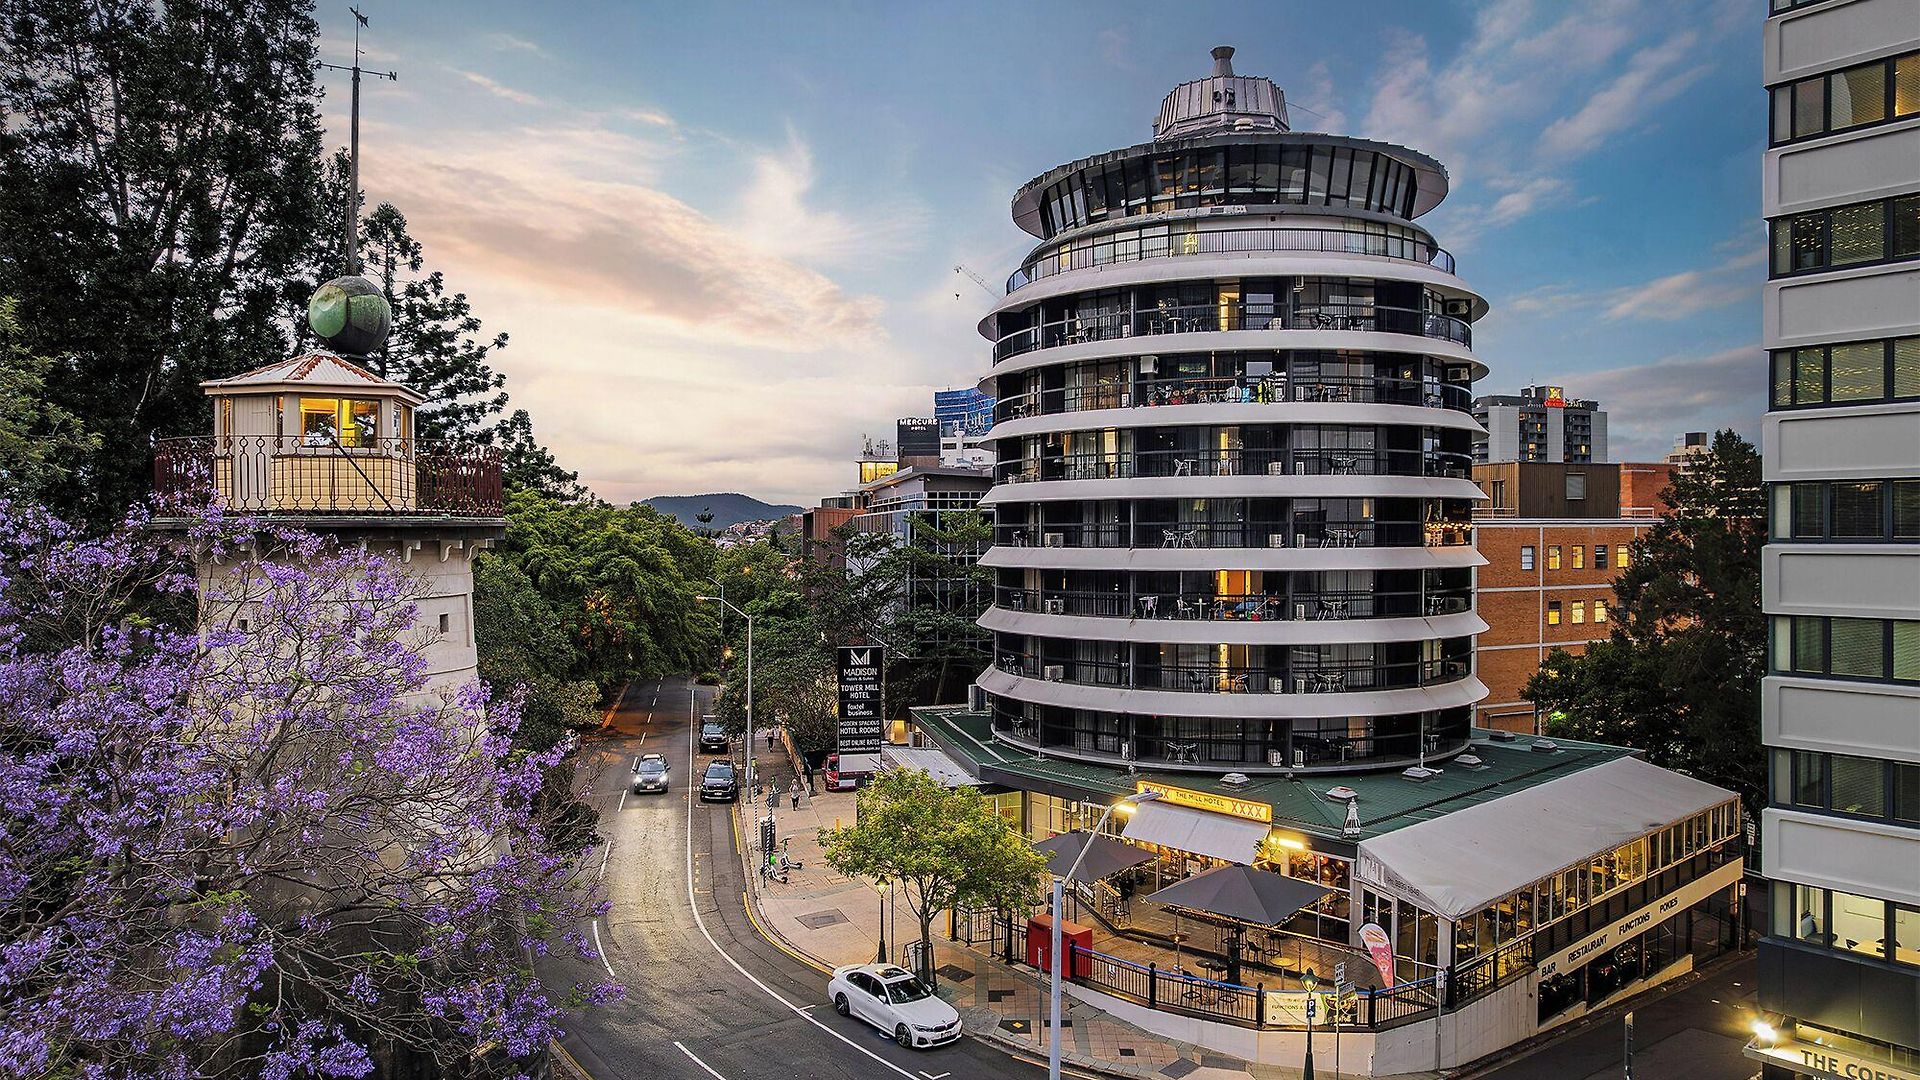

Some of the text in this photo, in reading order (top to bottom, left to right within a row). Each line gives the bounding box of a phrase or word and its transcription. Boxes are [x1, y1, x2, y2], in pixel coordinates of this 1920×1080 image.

[843, 667, 878, 677] MADISON
[841, 684, 864, 692] TOWER
[859, 726, 880, 734] ROOMS
[866, 738, 880, 746] RATES
[1176, 791, 1187, 799] THE
[1188, 794, 1202, 802] MILL
[1204, 797, 1225, 806] HOTEL
[1231, 800, 1262, 818] XXXX
[1541, 897, 1679, 977] BAR RESTAURANT FUNCTIONS POKIES
[1309, 1001, 1315, 1010] P
[1800, 1049, 1908, 1080] THE COF
